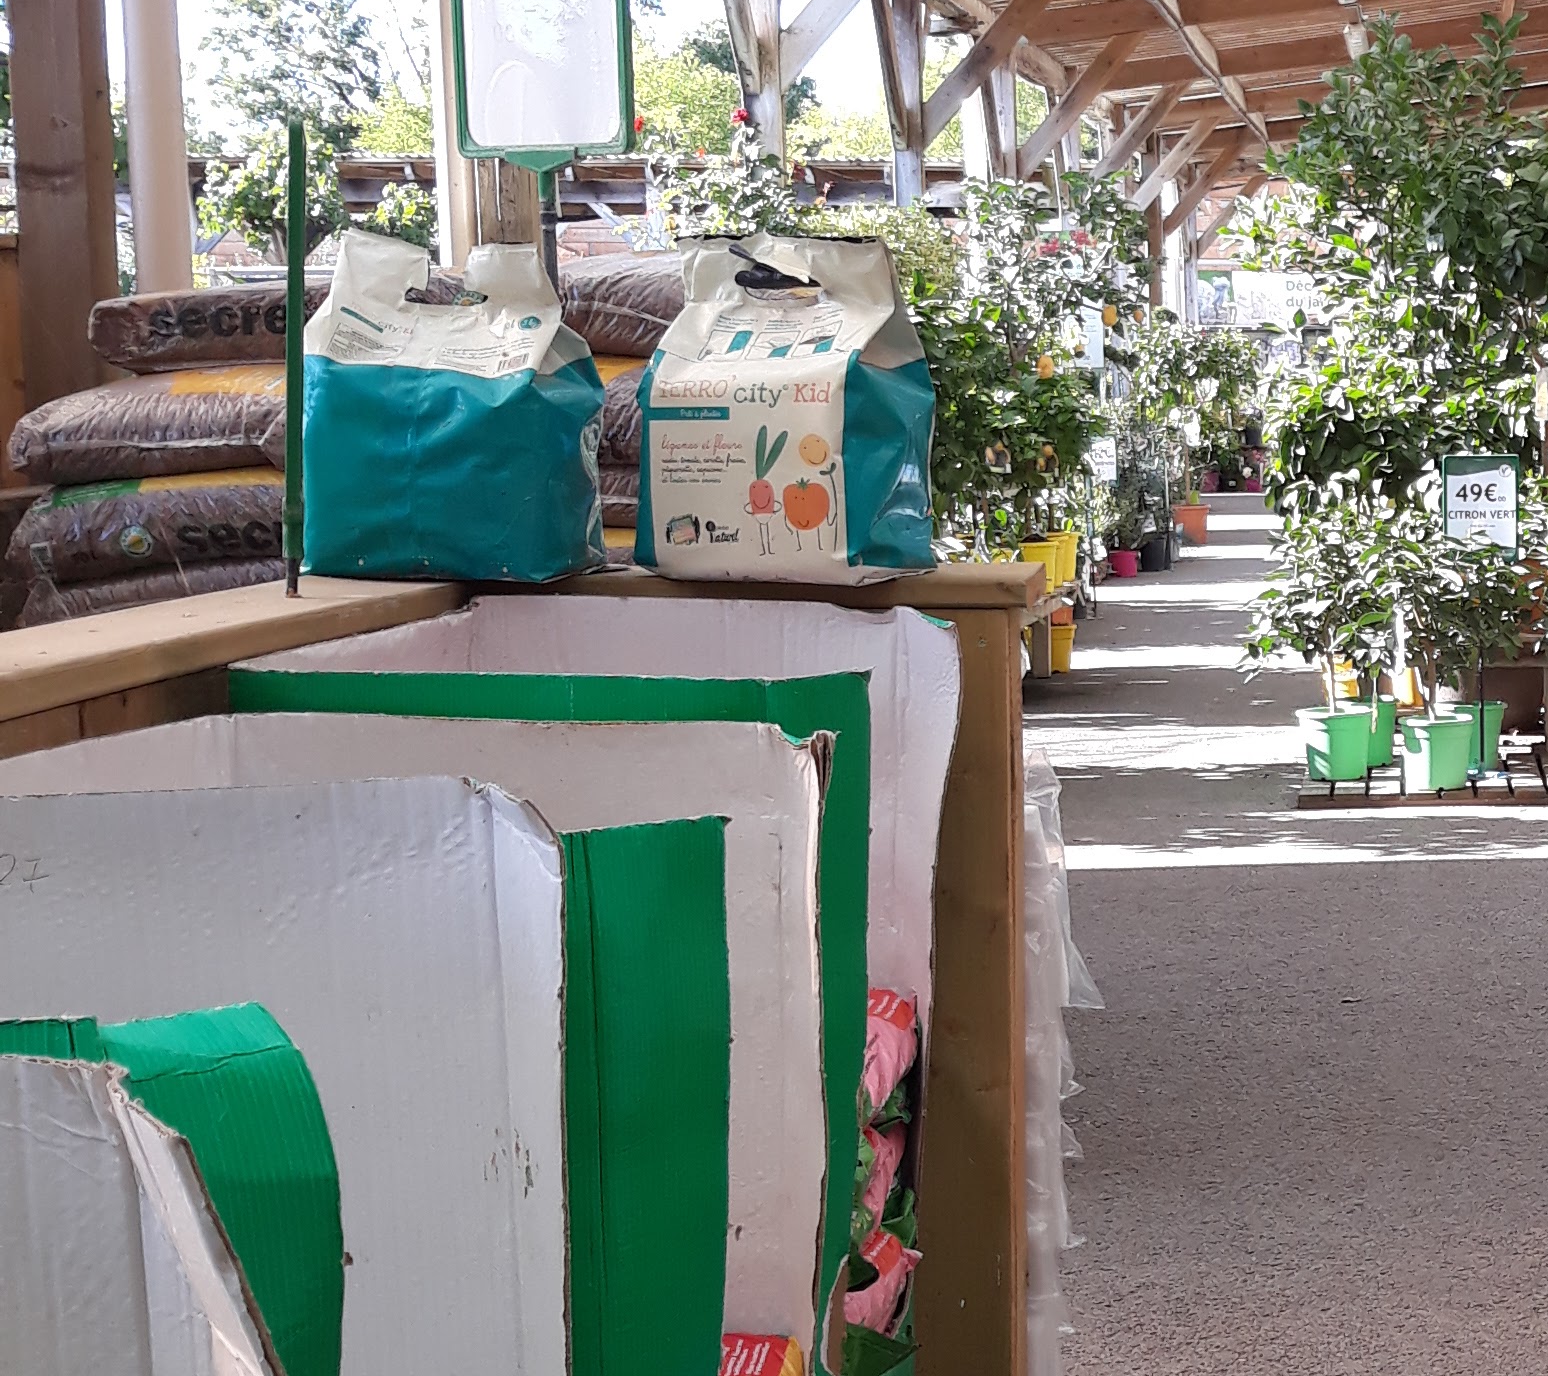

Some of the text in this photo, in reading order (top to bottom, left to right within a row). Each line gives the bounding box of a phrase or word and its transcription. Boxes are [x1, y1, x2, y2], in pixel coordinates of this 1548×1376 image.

[1286, 280, 1312, 292] Déc
[150, 305, 286, 338] secre
[793, 381, 831, 403] Kid
[1448, 510, 1516, 520] CITRON VERT
